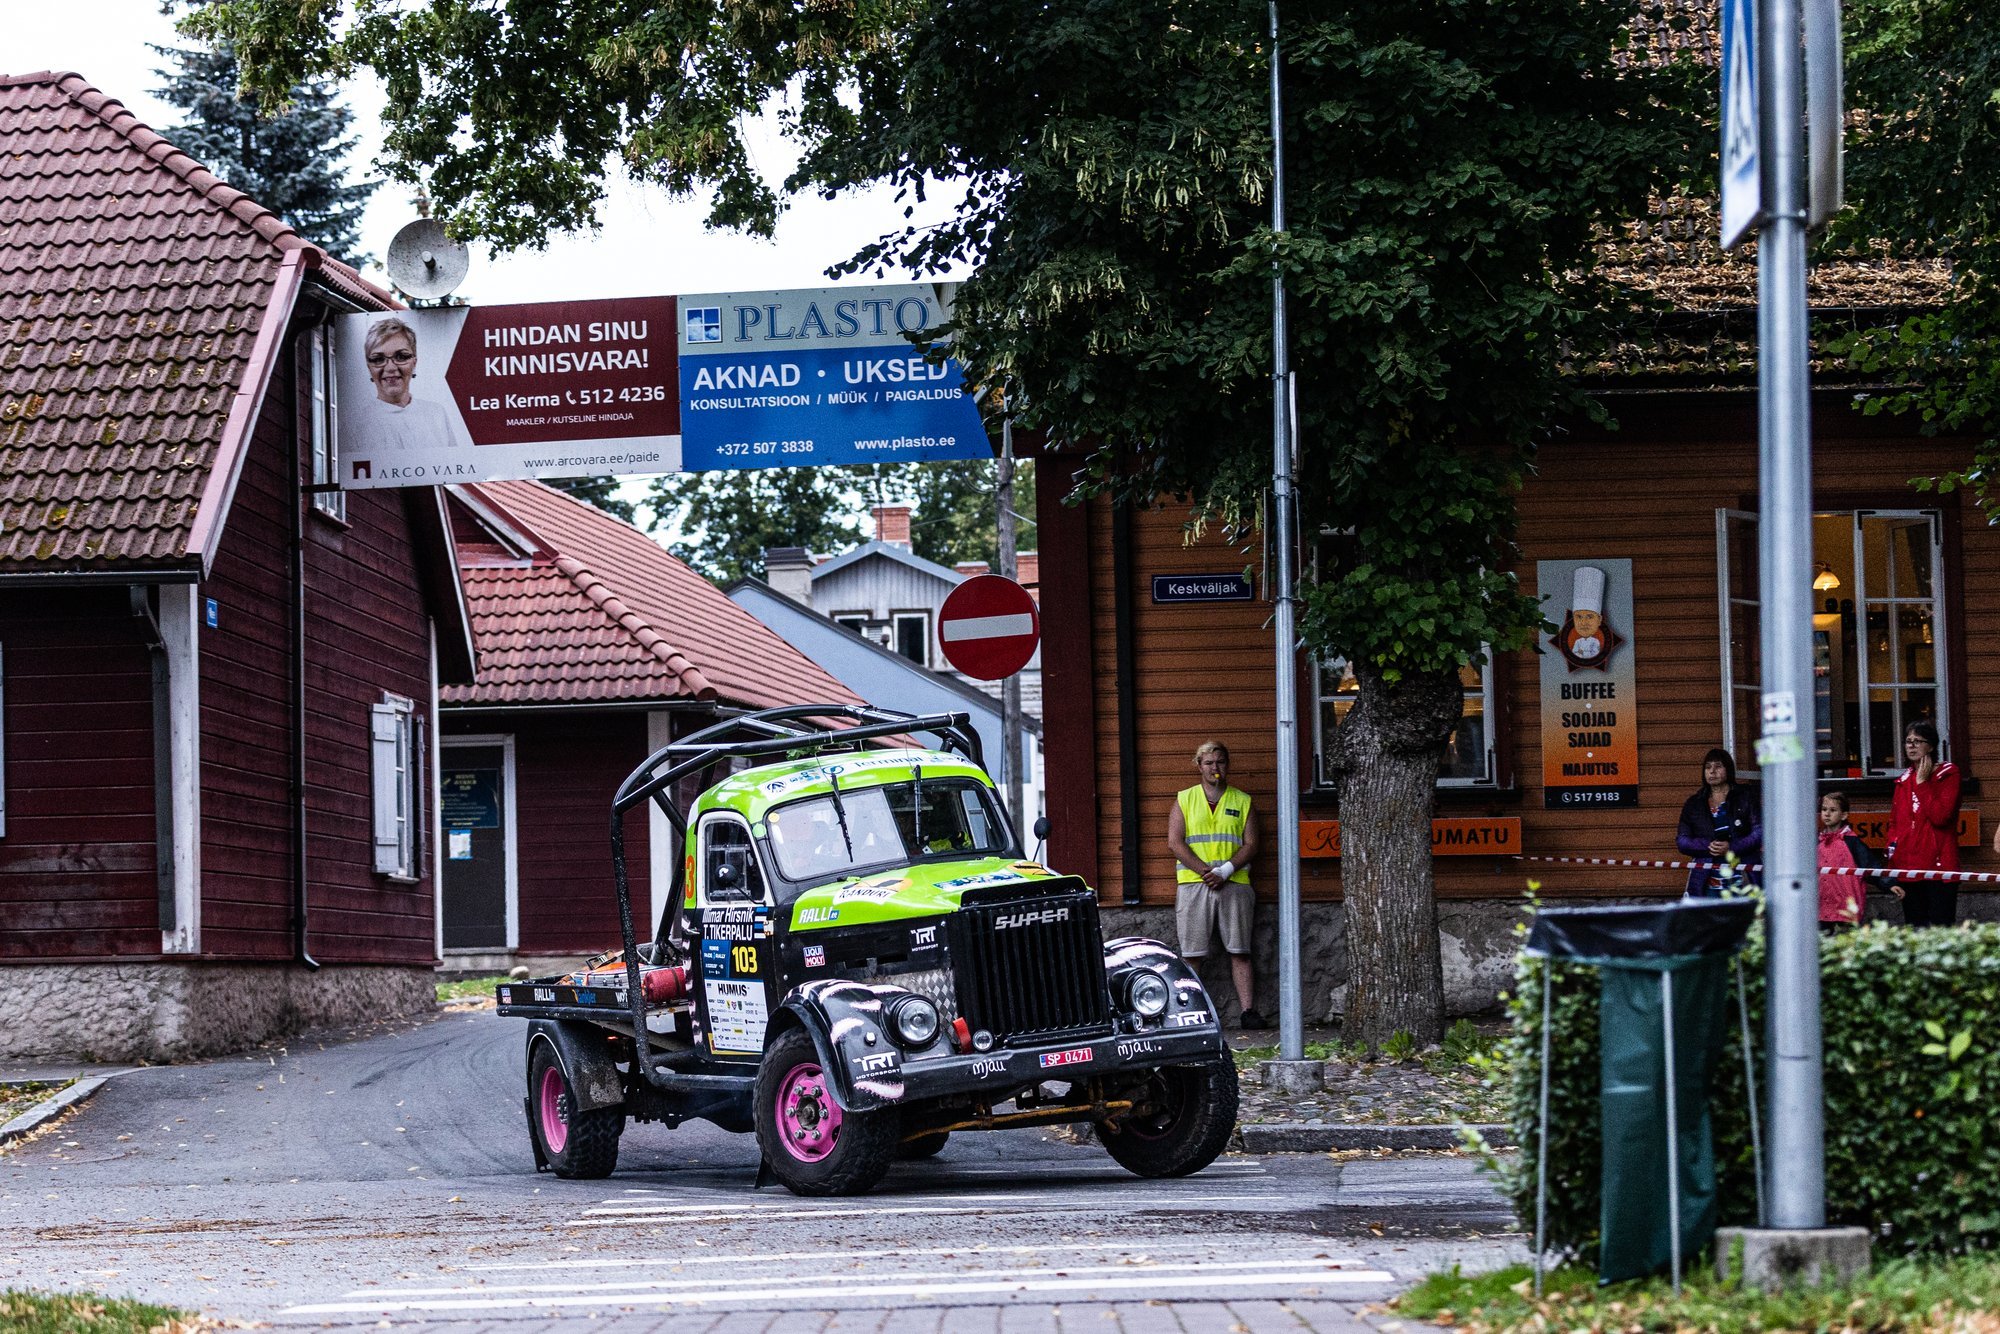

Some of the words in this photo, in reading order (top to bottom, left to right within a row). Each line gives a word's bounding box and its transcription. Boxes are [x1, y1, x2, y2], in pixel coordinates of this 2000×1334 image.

[733, 297, 930, 342] PLASTO
[484, 324, 581, 348] HINDAN
[588, 320, 648, 342] SINU
[485, 348, 649, 377] KINNISVARA!
[693, 363, 801, 391] AKNAD
[844, 357, 948, 384] UKSED
[470, 396, 500, 411] Lea
[505, 392, 560, 409] Kerma
[580, 388, 614, 405] 512
[618, 386, 665, 403] 4236
[690, 395, 810, 411] KONSULTATSIOON
[816, 394, 822, 405] /
[828, 391, 868, 405] MÜÜK
[885, 388, 962, 403] PAIGALDUS
[506, 417, 545, 427] MAAKLER
[552, 414, 597, 424] KUTSELINE
[598, 412, 634, 422] HINDAJA
[716, 443, 749, 456] +372
[753, 442, 777, 455] 507
[781, 440, 814, 453] 3838
[854, 436, 956, 451] www.plasto.ee
[524, 451, 660, 470] www.arcovara.ee/paide
[379, 467, 425, 479] ARCO
[433, 464, 477, 476] VARA
[1168, 582, 1238, 595] Keskväljak
[1560, 682, 1616, 700] BUFFEE
[1562, 712, 1617, 728] SOOJAD
[1568, 732, 1612, 748] SAIAD
[1562, 762, 1619, 776] MAJUTUS
[1574, 792, 1593, 802] 517
[1596, 792, 1620, 801] 9183
[995, 907, 1069, 930] SUPER
[703, 924, 753, 941] T.TIKERPALU
[805, 947, 822, 957] LIQUI
[911, 943, 939, 952] MOTORSPORT
[731, 946, 758, 973] 103
[806, 956, 824, 966] MOLY
[717, 983, 748, 997] HUMUS
[852, 1051, 897, 1072] TRT
[1047, 1053, 1061, 1066] SP
[1065, 1048, 1090, 1063] 0471
[855, 1068, 900, 1081] MOTORSPORT
